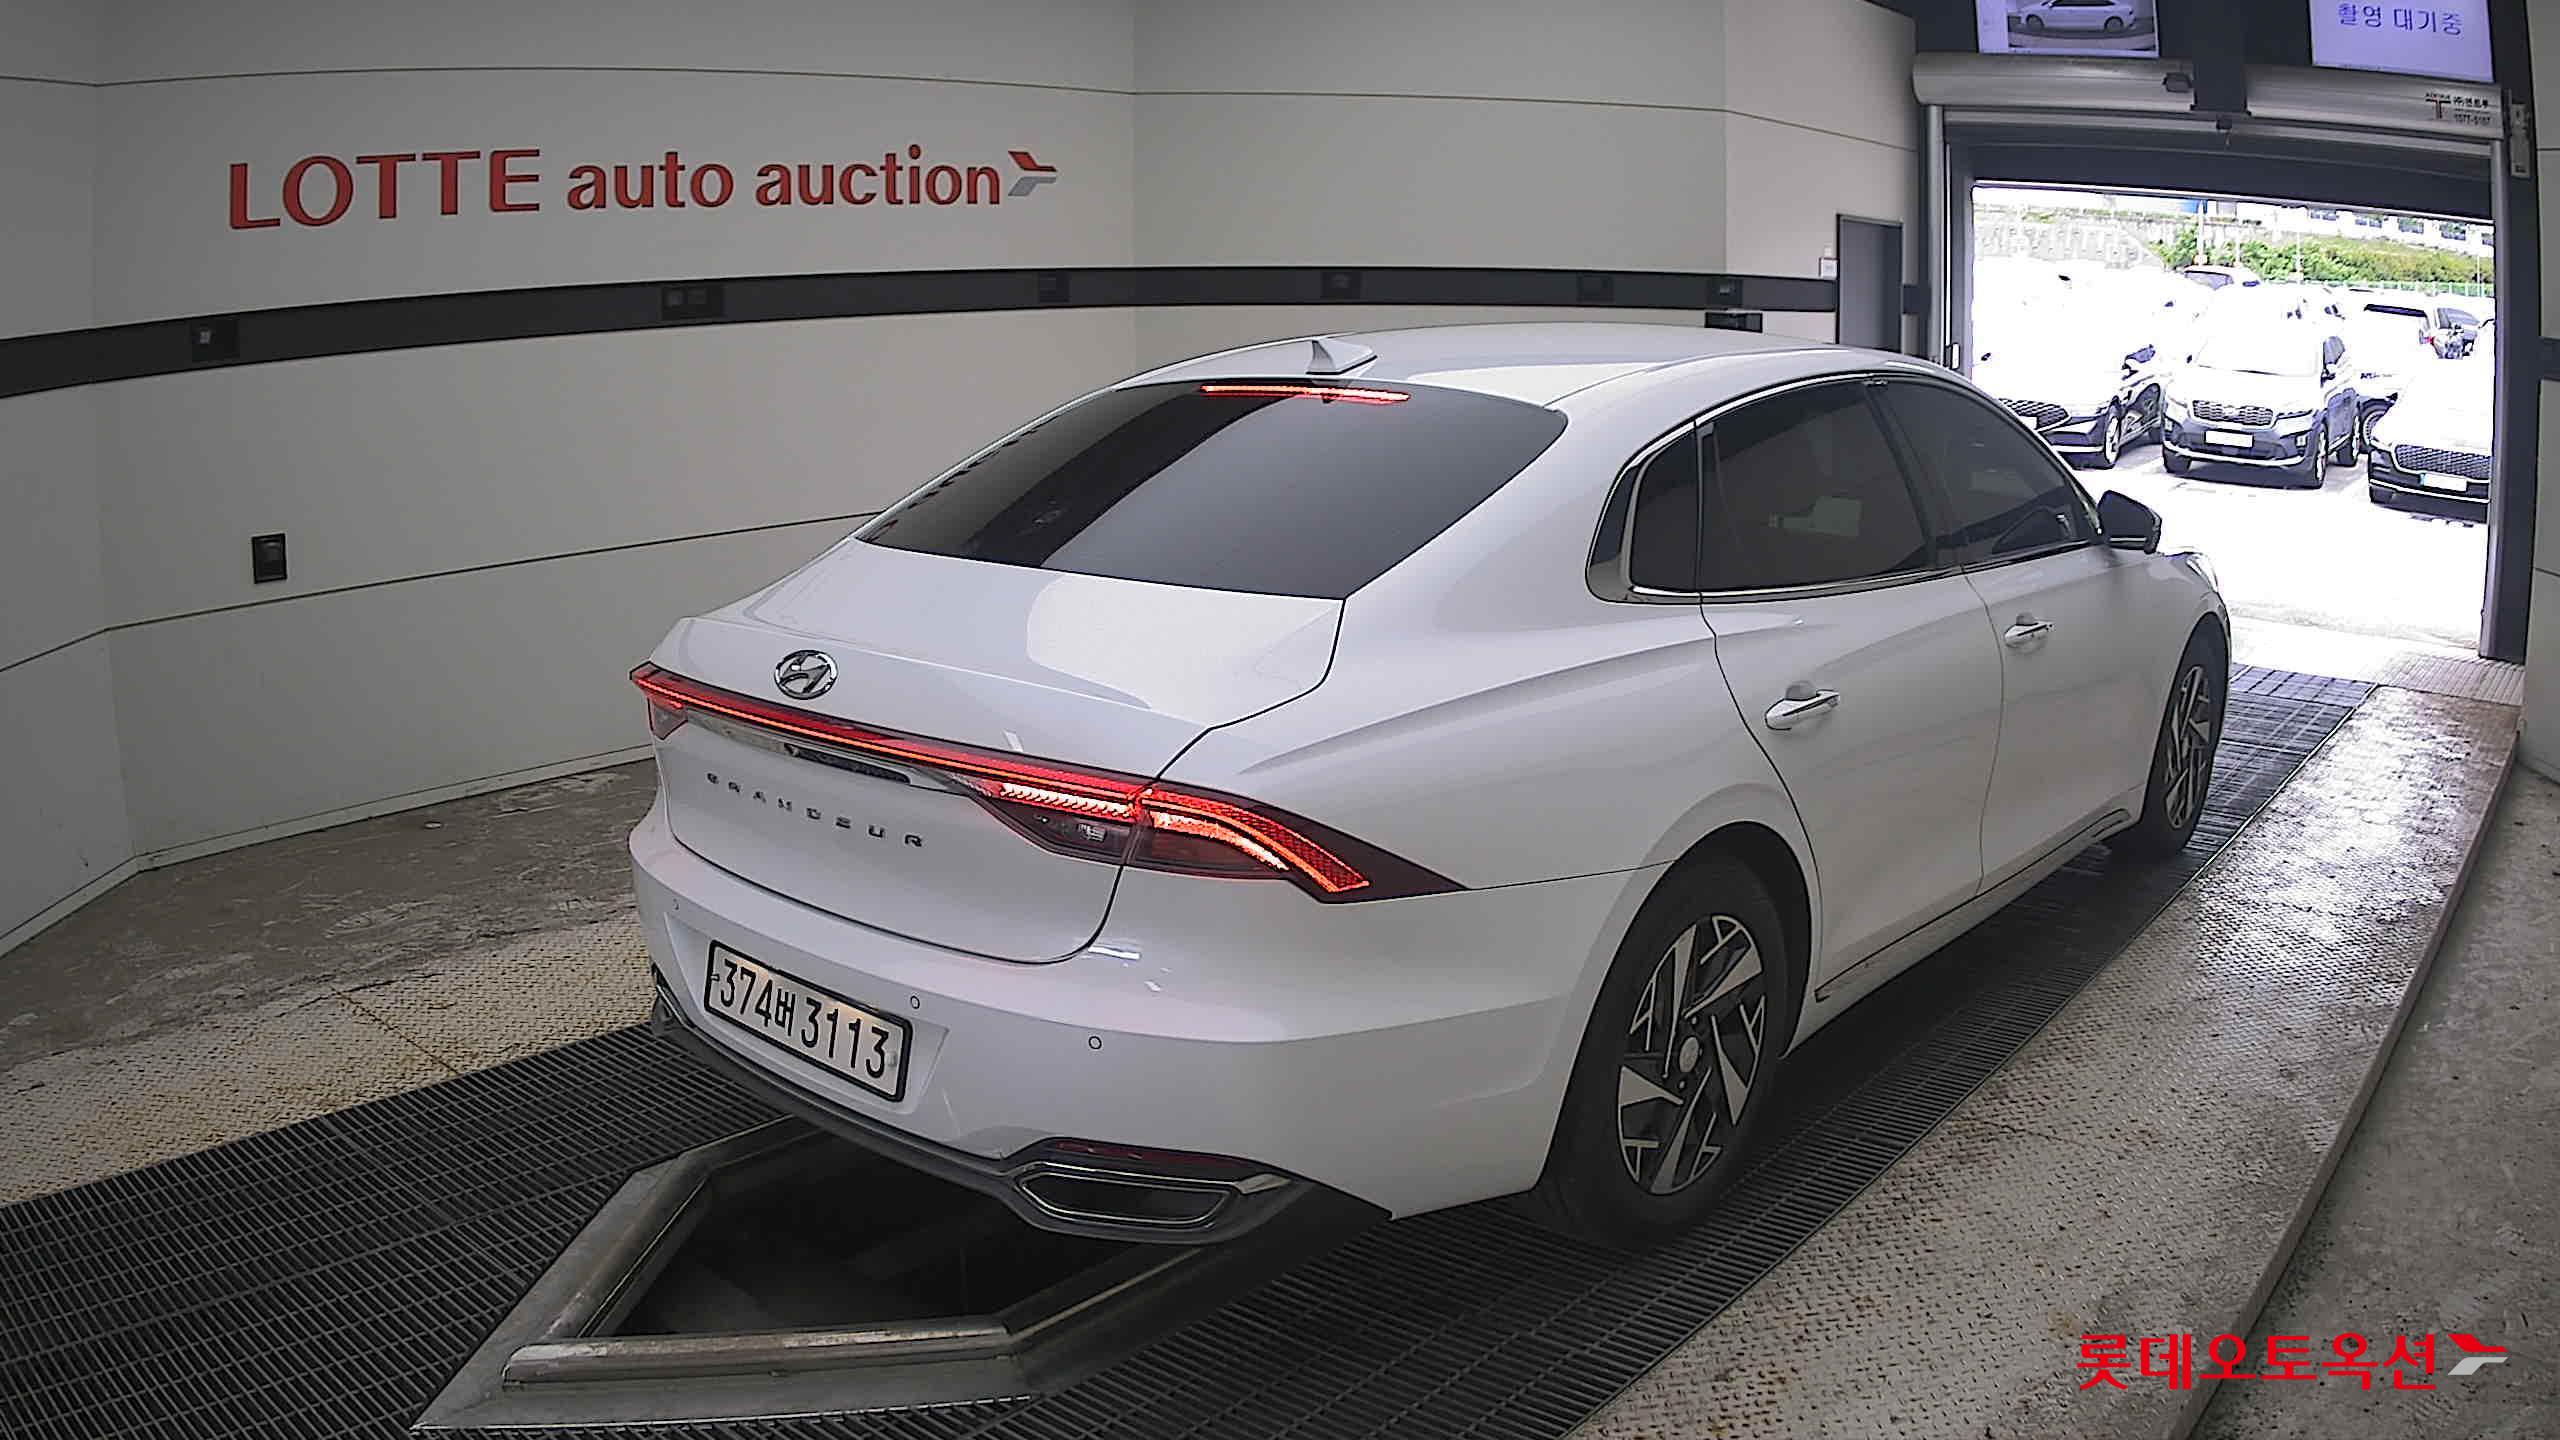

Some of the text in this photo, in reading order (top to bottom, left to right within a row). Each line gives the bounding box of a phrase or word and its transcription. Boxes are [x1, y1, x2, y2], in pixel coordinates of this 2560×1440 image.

[2338, 3, 2463, 36] 촬영 대기중
[229, 144, 1002, 230] LOTTE auto auction
[706, 772, 924, 848] GRANDEUR
[720, 958, 889, 1078] 374버 3113
